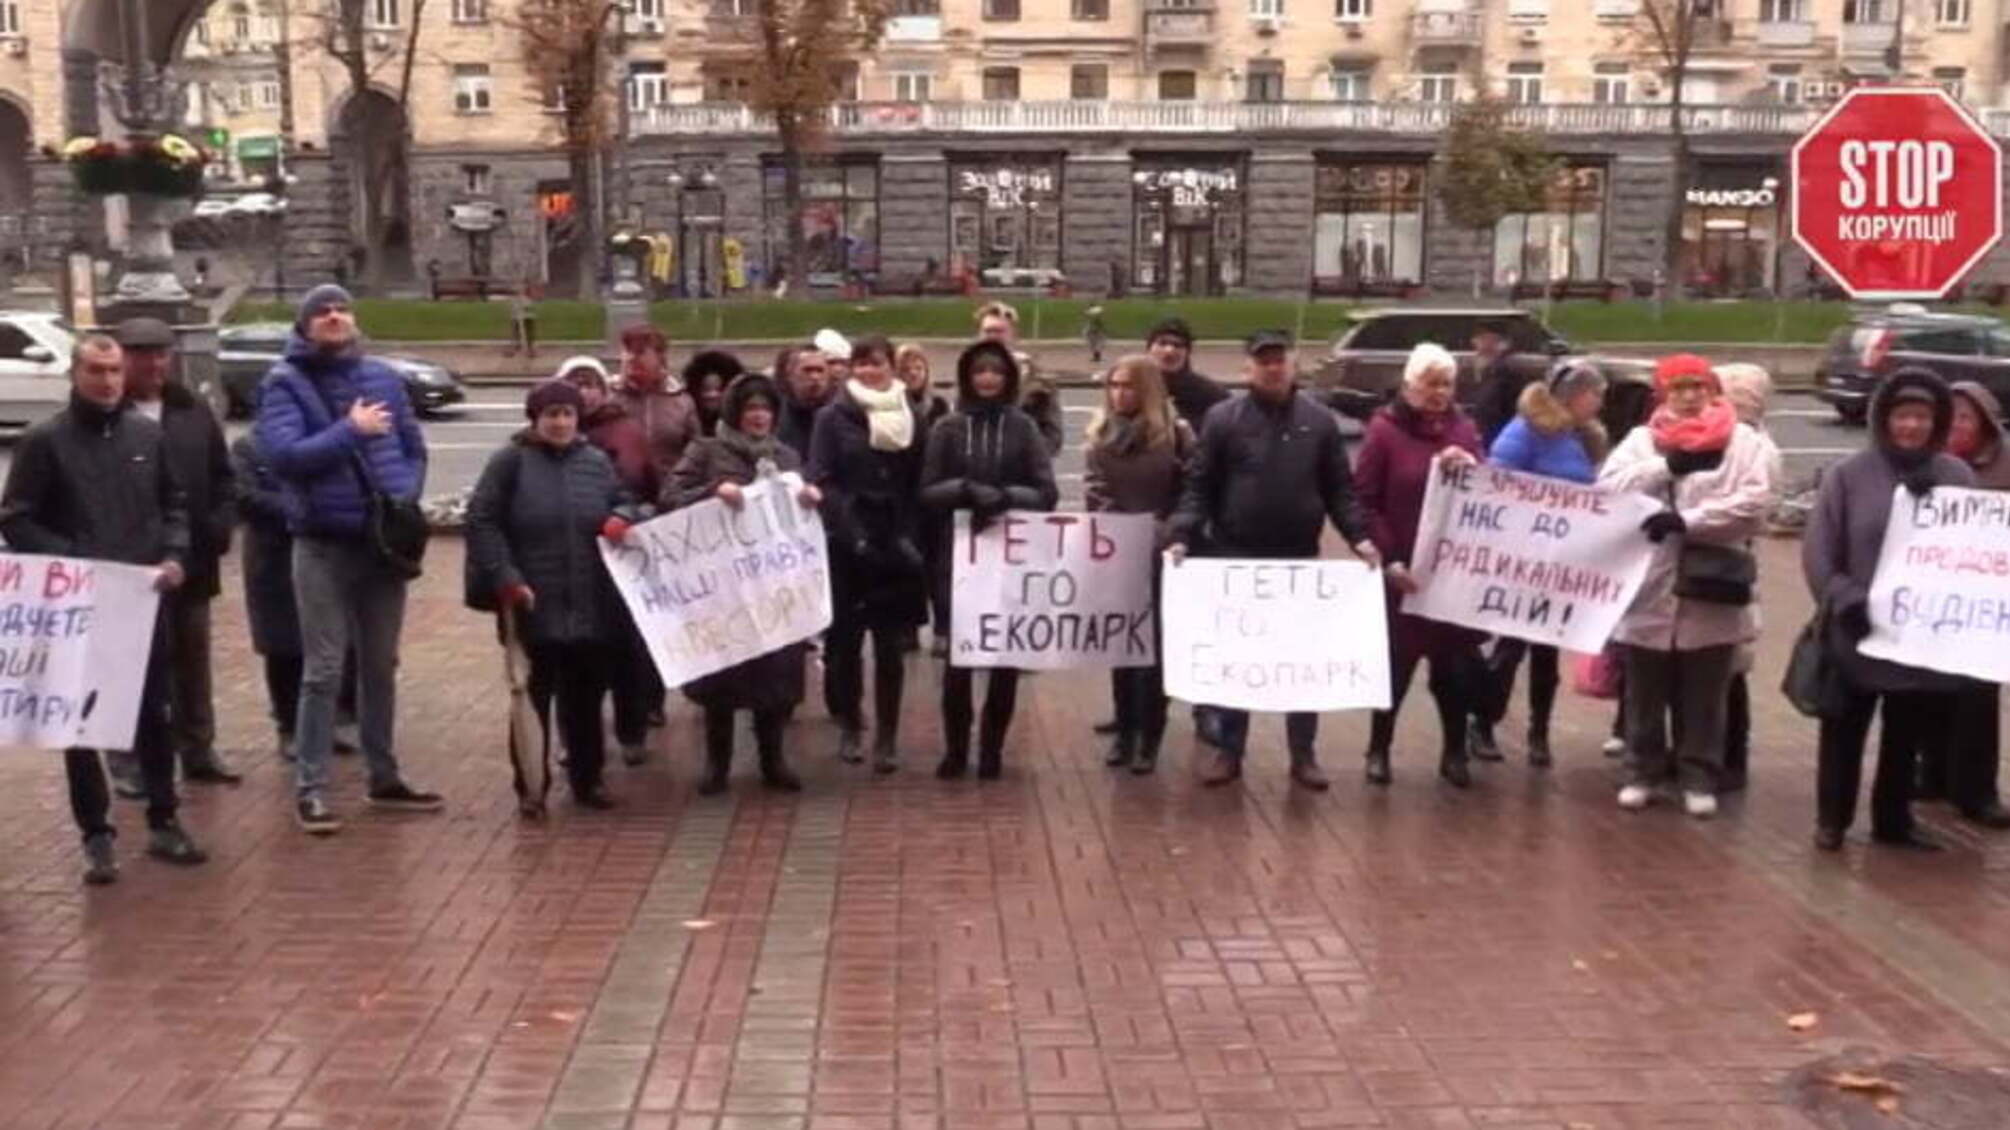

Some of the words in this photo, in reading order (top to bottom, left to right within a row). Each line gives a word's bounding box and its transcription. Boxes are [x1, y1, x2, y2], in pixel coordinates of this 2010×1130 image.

[1458, 501, 1509, 531] НАС
[1531, 513, 1571, 538] ДО
[1022, 571, 1076, 606] ГО
[1223, 565, 1338, 600] ГЕТЬ
